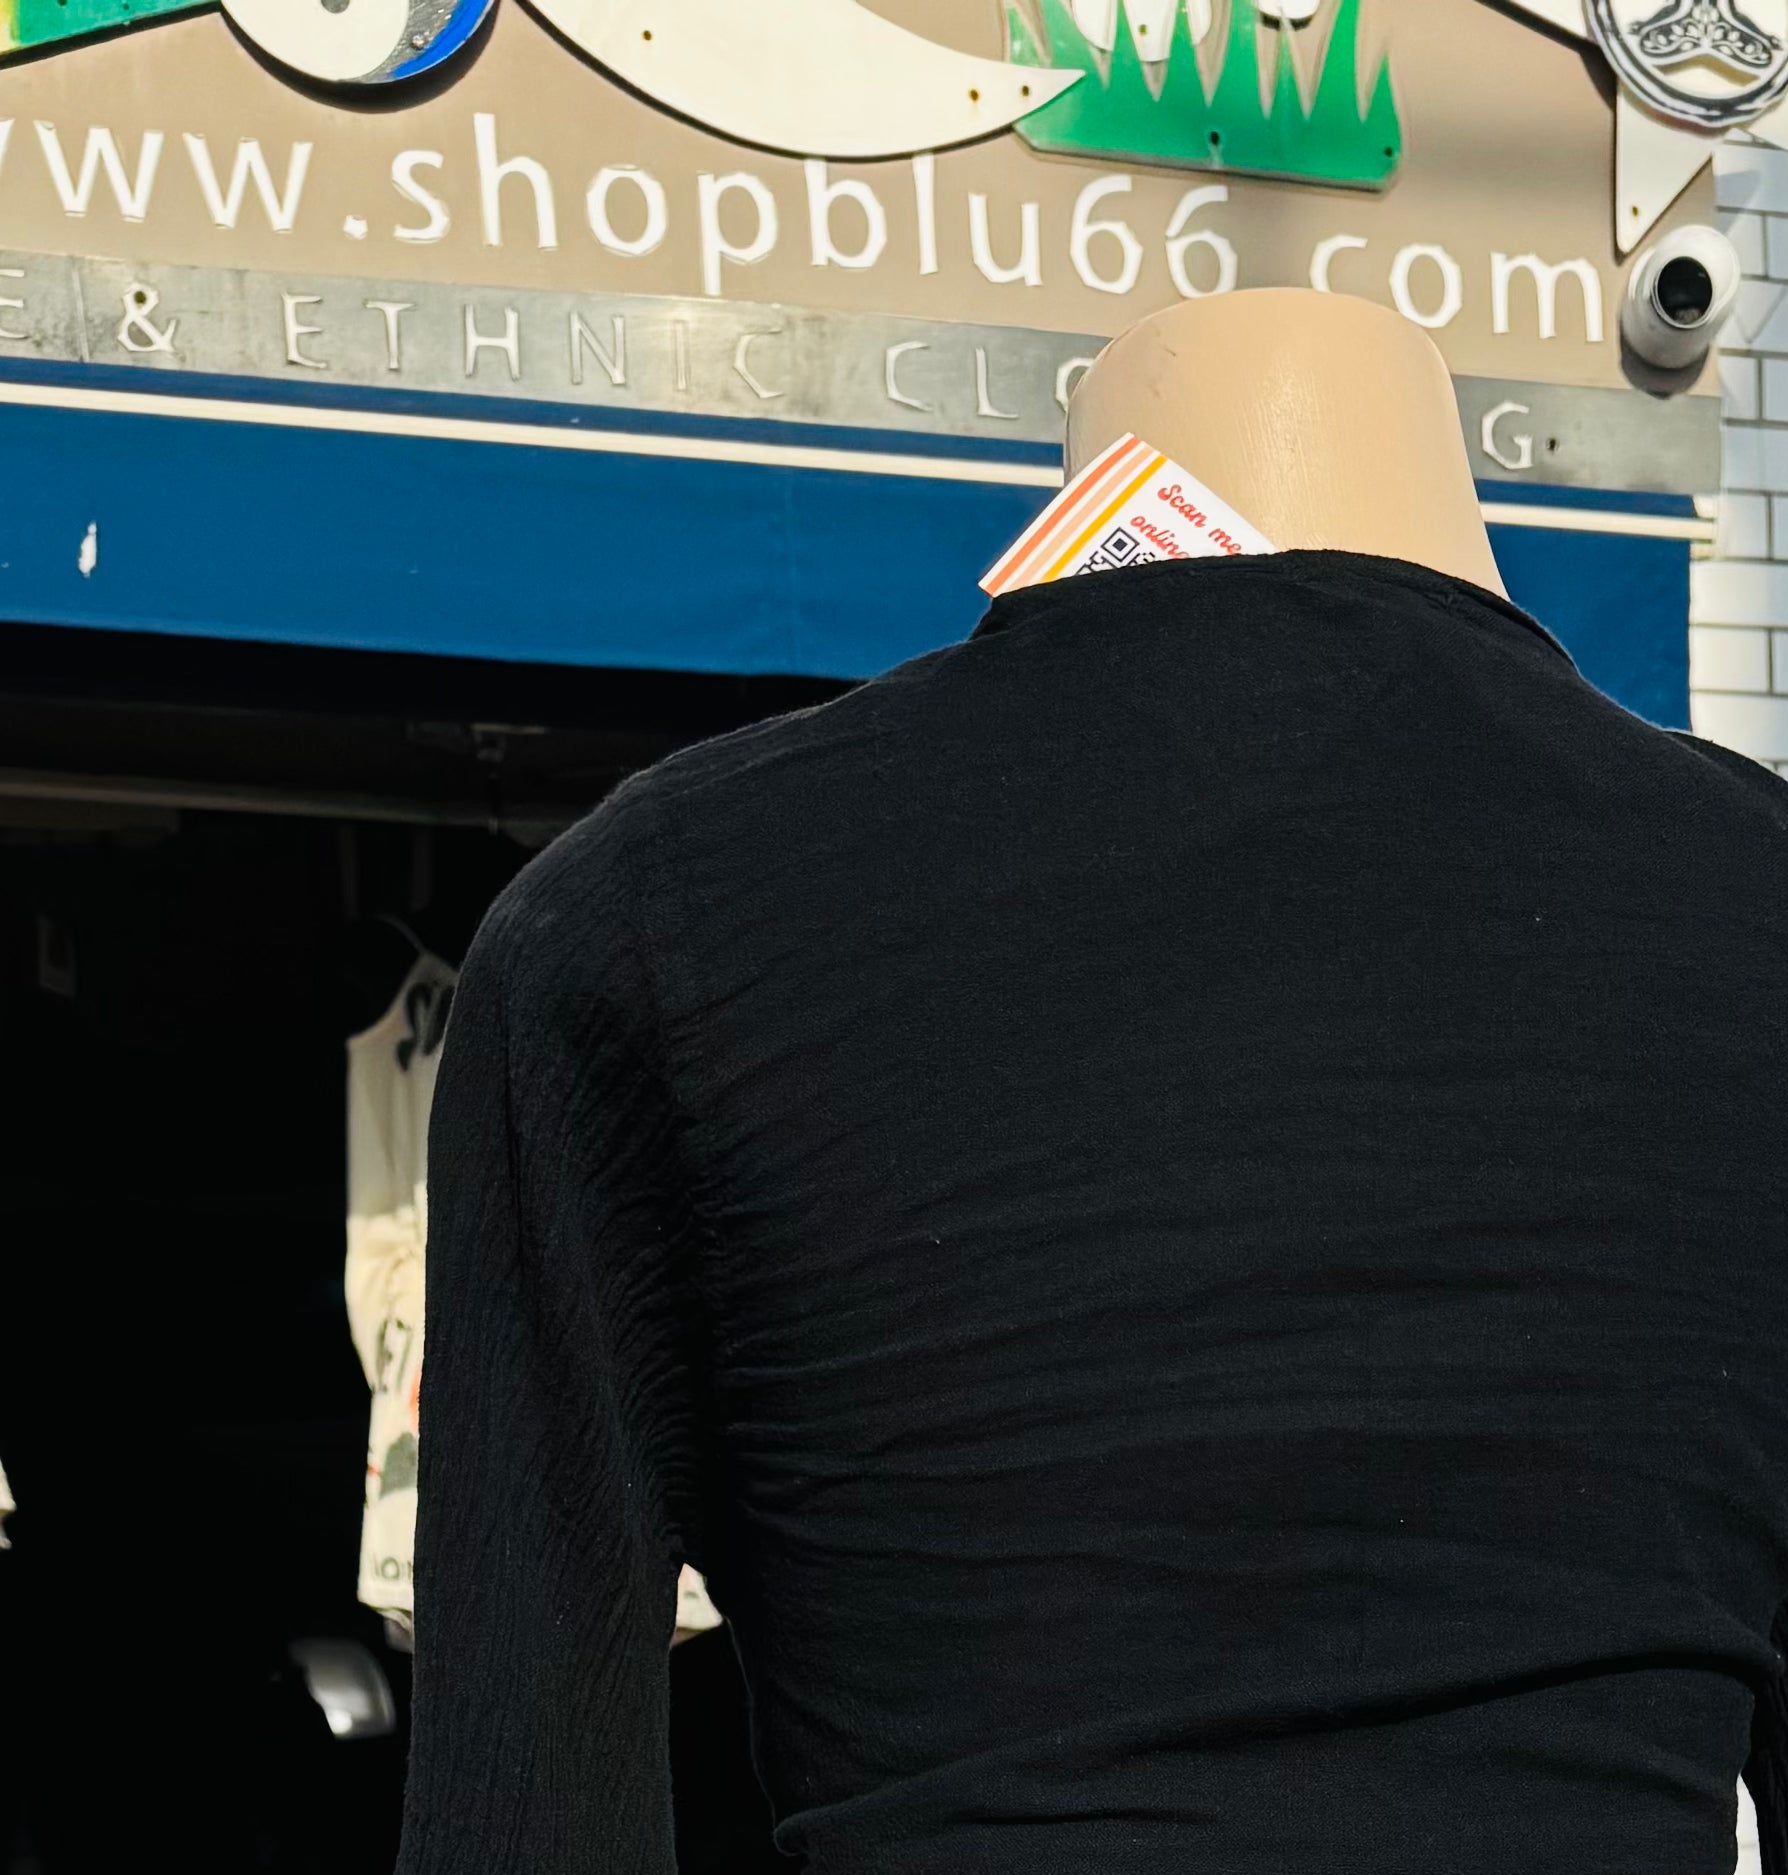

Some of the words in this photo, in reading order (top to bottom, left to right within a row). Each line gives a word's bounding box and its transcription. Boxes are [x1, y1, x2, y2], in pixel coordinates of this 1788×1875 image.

[117, 281, 180, 354] &
[280, 291, 784, 399] ETHNIC
[1157, 483, 1208, 528] Scan
[1207, 527, 1242, 556] me
